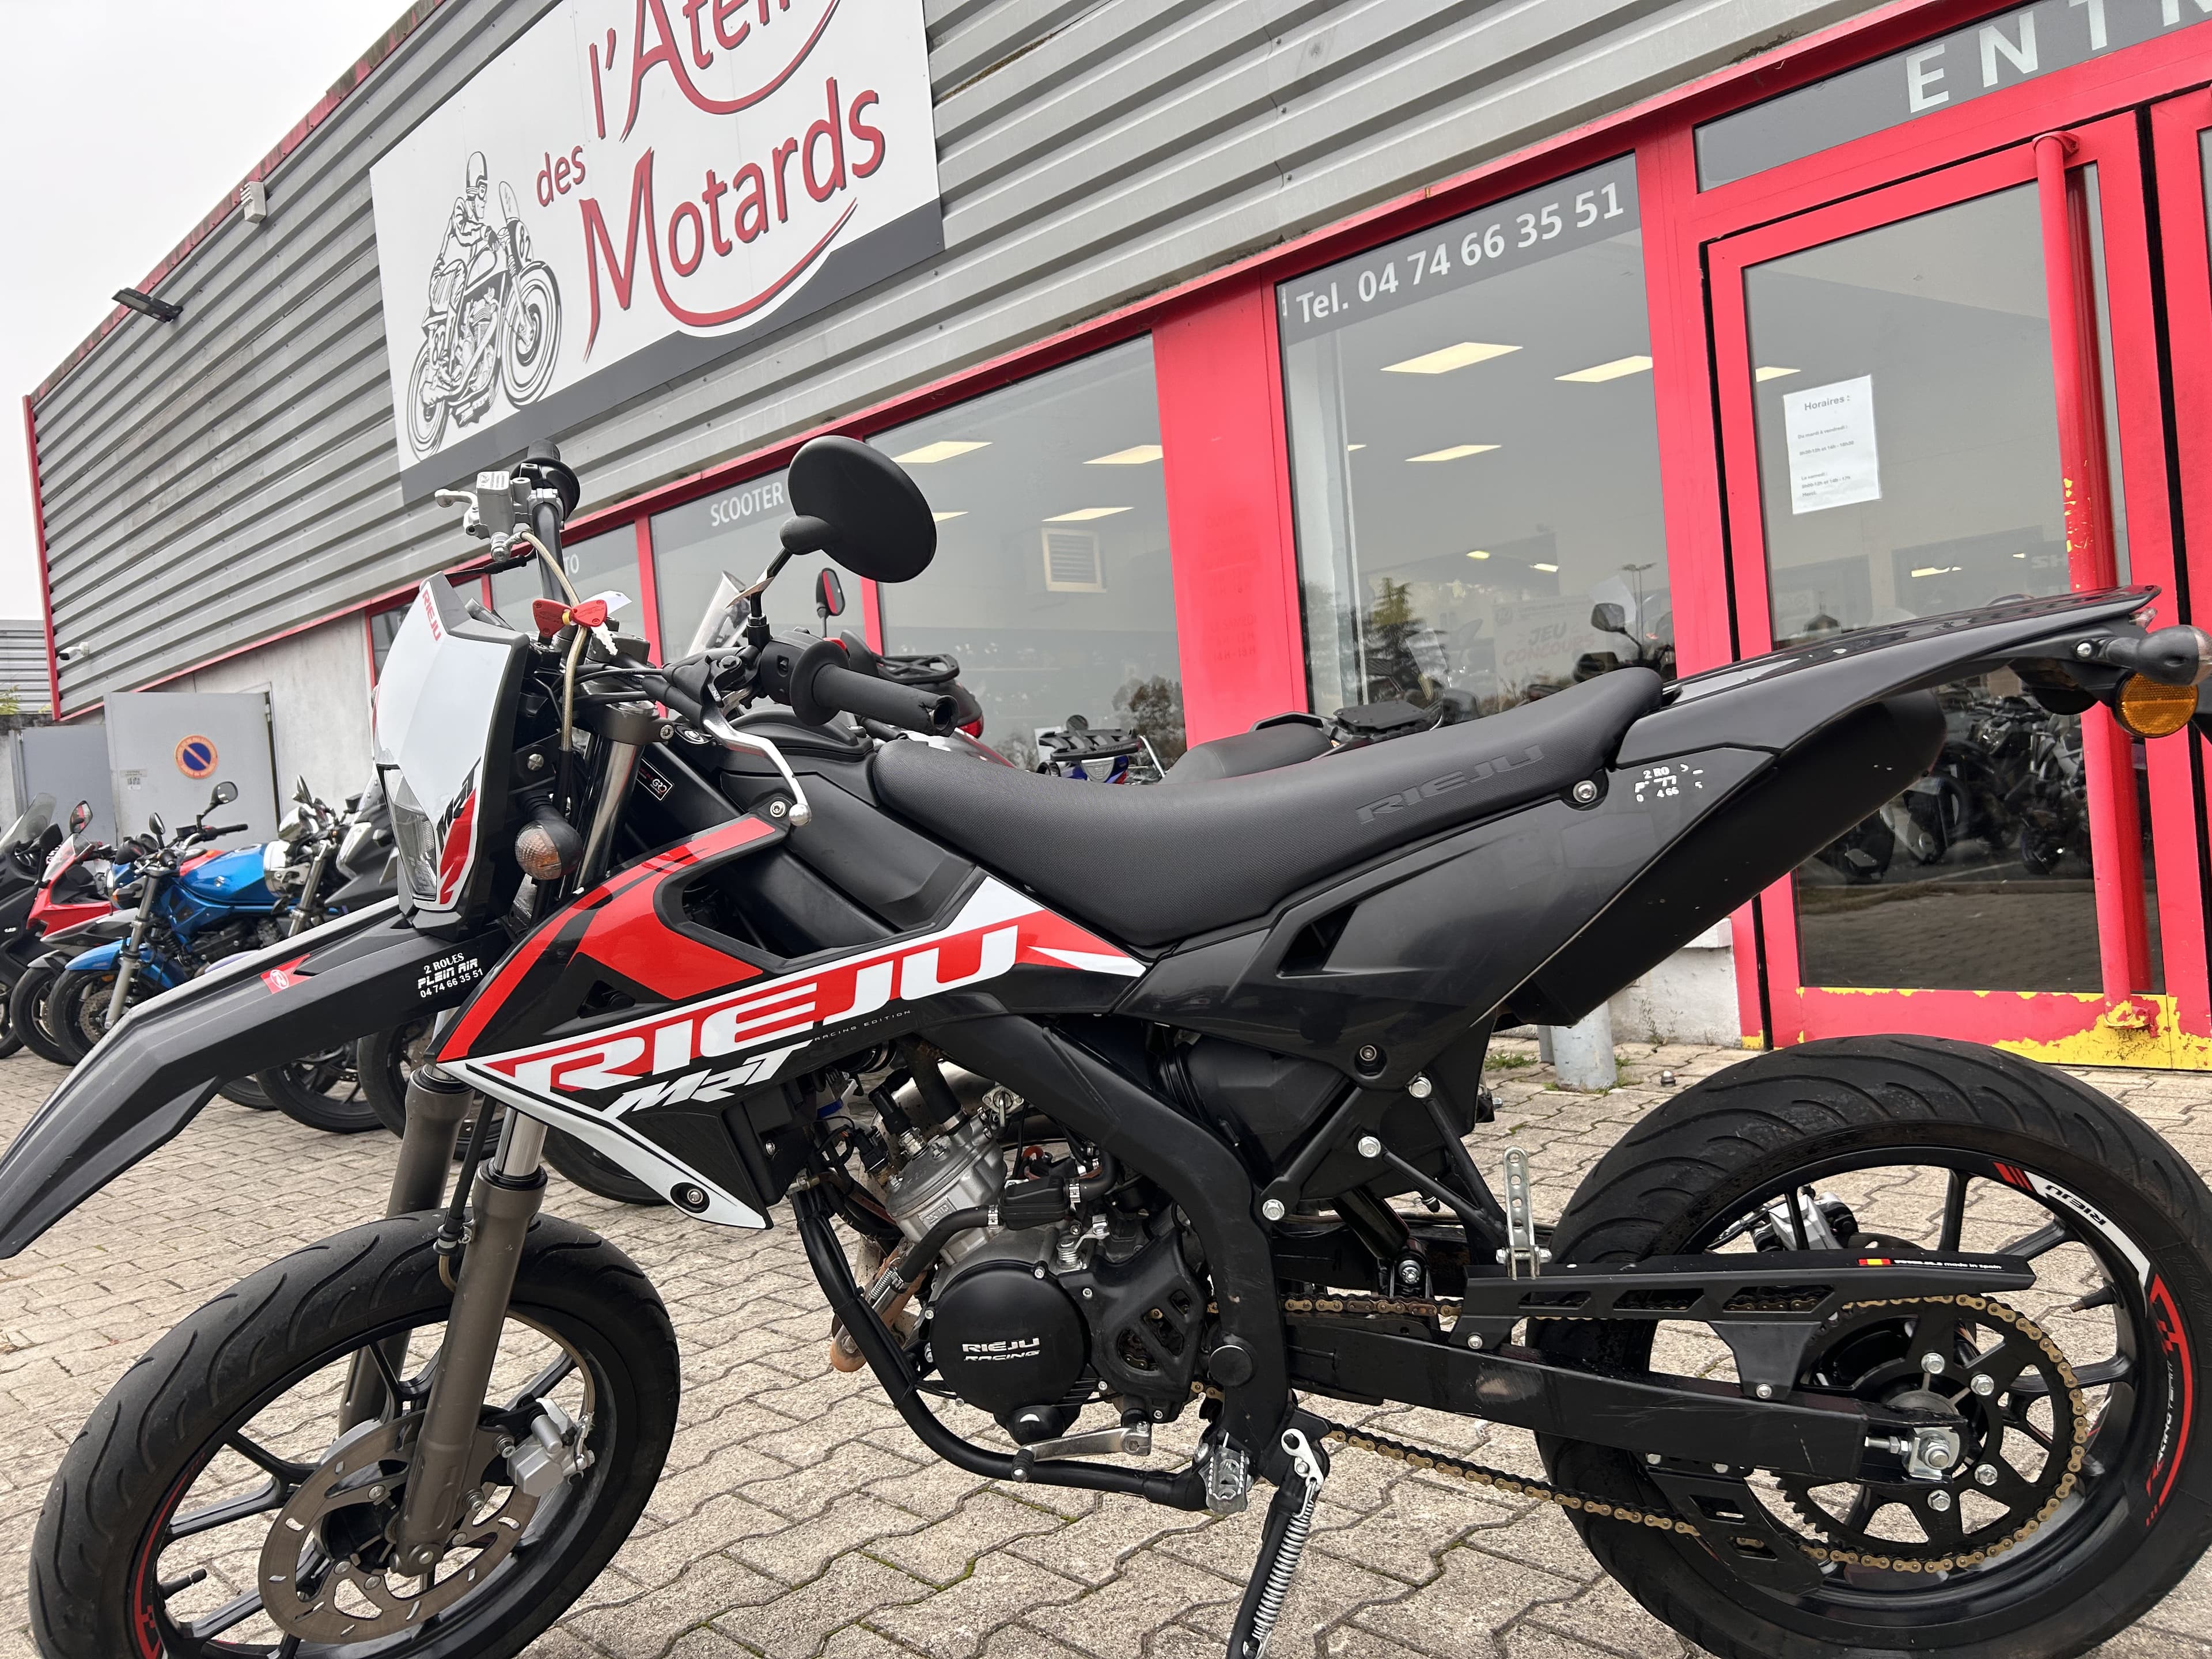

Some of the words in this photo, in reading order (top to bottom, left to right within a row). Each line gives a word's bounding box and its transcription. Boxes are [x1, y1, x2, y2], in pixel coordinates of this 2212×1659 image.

[536, 145, 585, 207] des
[578, 76, 885, 363] Motards
[1296, 282, 1349, 324] Tel.
[1357, 262, 1399, 302] 04
[1407, 243, 1450, 285] 74
[1460, 224, 1505, 266] 66
[1516, 202, 1562, 248] 35
[1575, 181, 1624, 228] 51
[1804, 396, 1844, 411] Horaires
[710, 482, 784, 527] SCOOTER
[422, 589, 441, 642] RIEJU
[1355, 744, 1545, 824] RIEJU
[420, 987, 433, 998] 04
[433, 983, 445, 993] 74
[446, 978, 459, 988] 66
[459, 972, 471, 983] 35
[472, 968, 484, 978] 51
[423, 965, 432, 974] 2
[512, 925, 1018, 1093] RIEJU
[815, 1025, 857, 1041] RACING
[863, 1010, 911, 1027] EDITION
[615, 1040, 813, 1116] MRT
[2045, 1184, 2107, 1226] RIEJU
[962, 1337, 1040, 1353] RIEJU
[963, 1350, 1040, 1362] RACING
